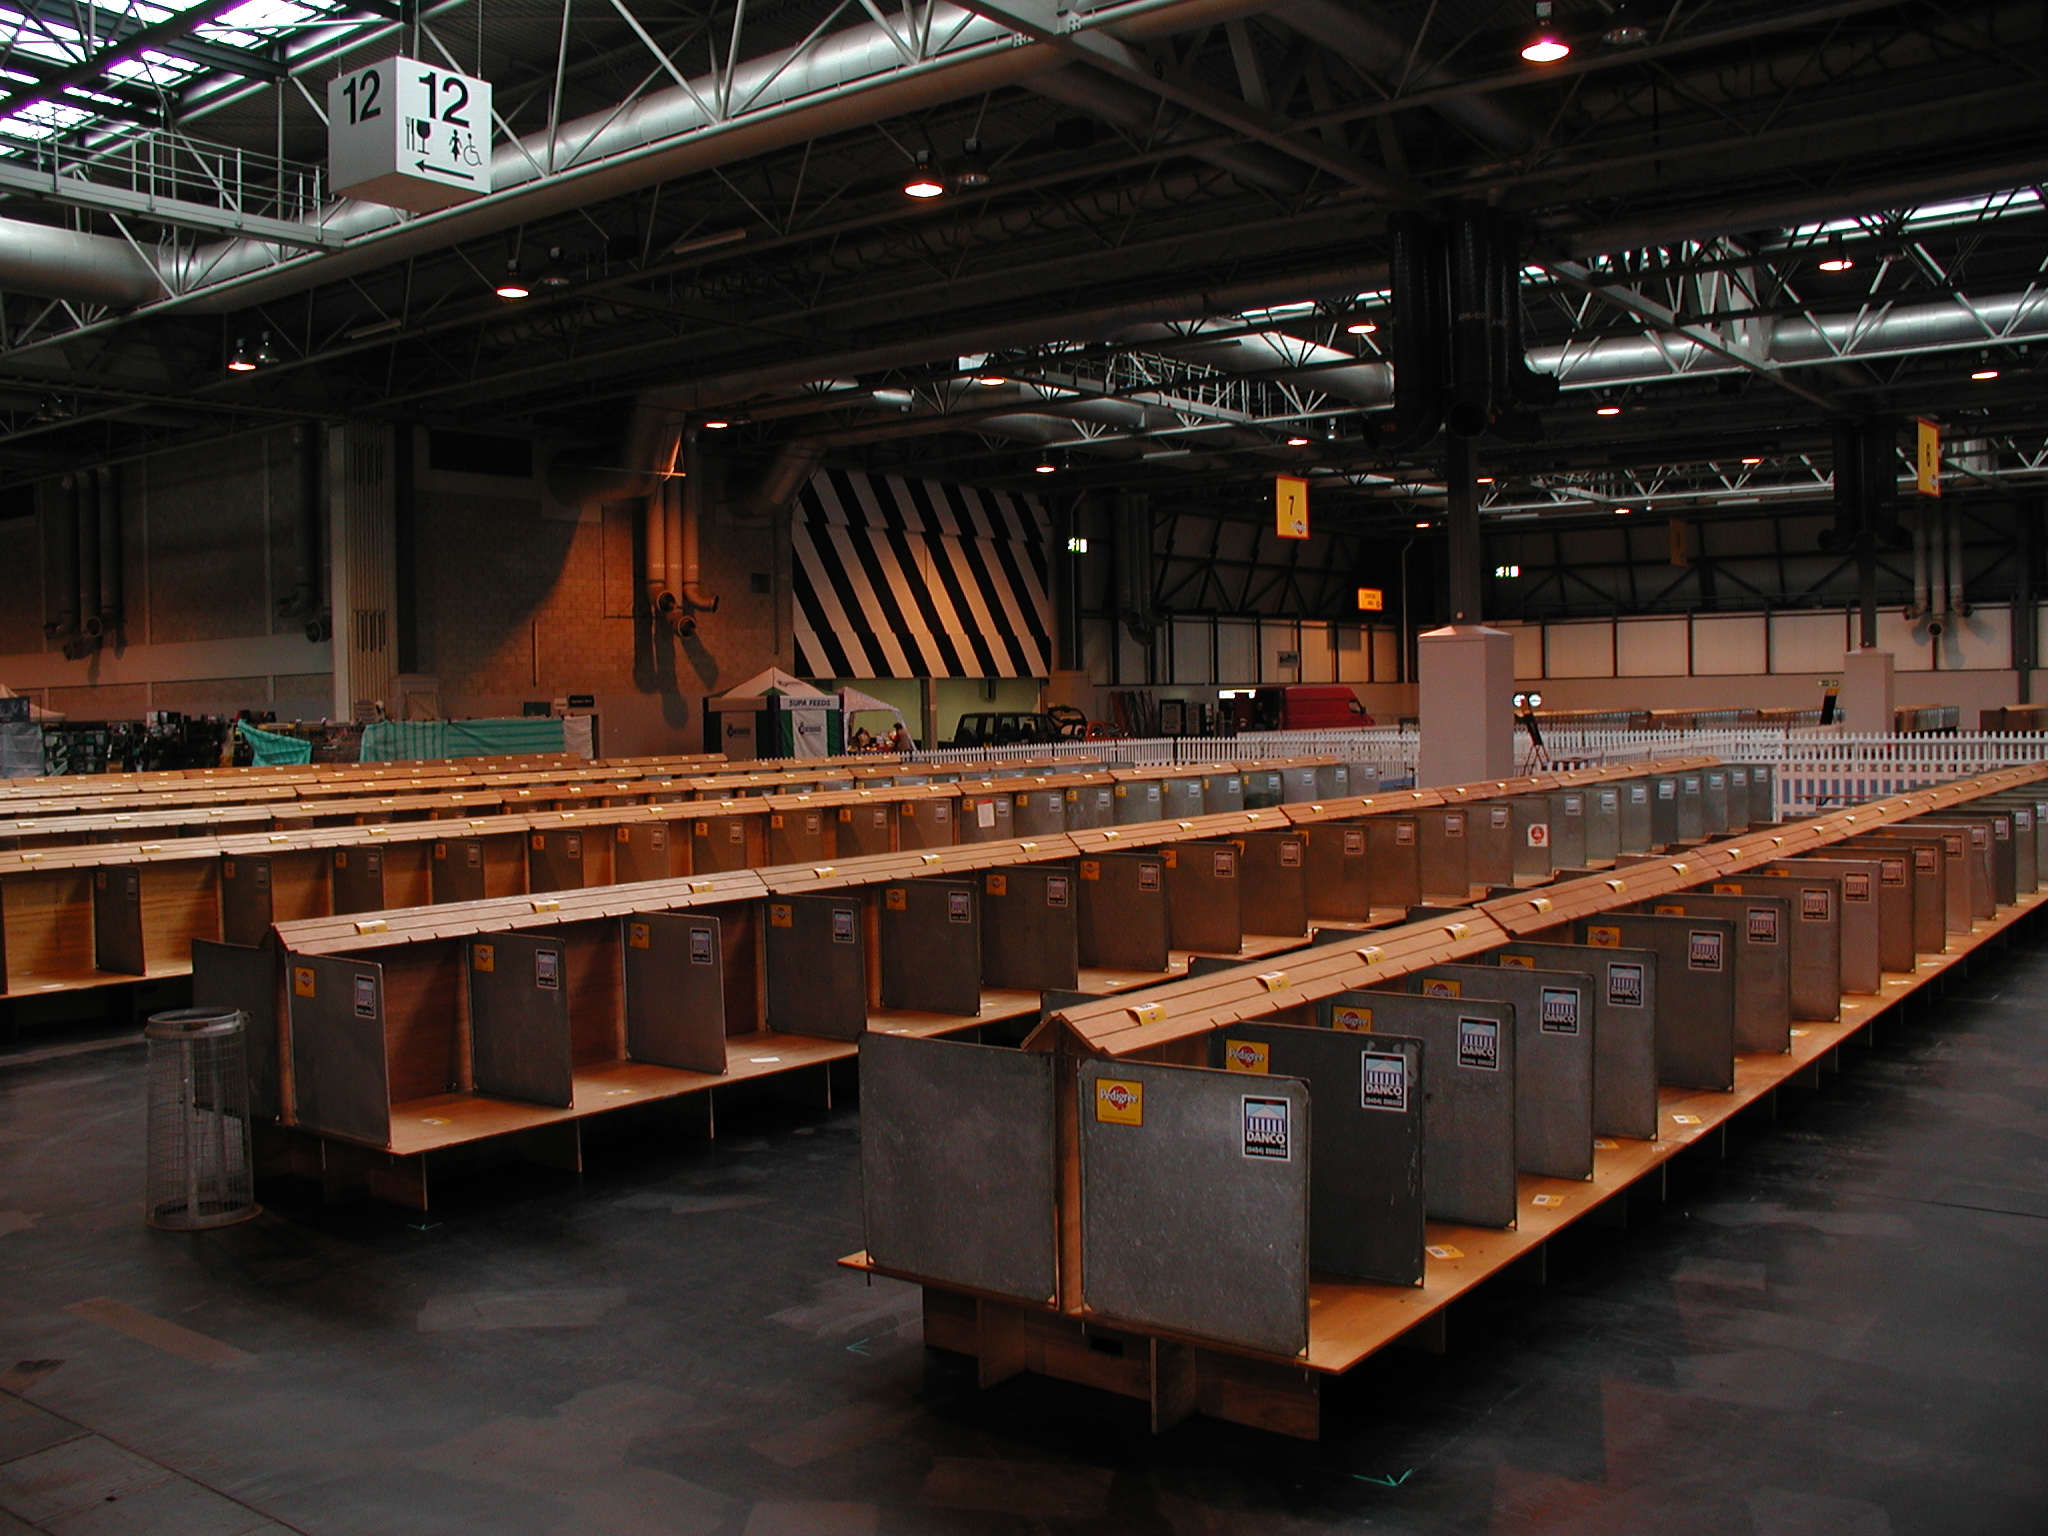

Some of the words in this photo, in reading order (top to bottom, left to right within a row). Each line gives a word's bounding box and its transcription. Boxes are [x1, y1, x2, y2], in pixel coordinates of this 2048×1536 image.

[343, 69, 381, 125] 12
[419, 71, 470, 128] 12
[1289, 496, 1295, 515] 7
[789, 699, 807, 707] SUPA
[1334, 1012, 1368, 1028] Pedigree
[1544, 1012, 1576, 1024] DANCO
[1228, 1047, 1265, 1065] Pedigree
[1461, 1045, 1496, 1057] DANCO
[1100, 1086, 1138, 1106] Pedigree
[1366, 1083, 1403, 1096] DANCO
[1246, 1131, 1287, 1145] DANCO
